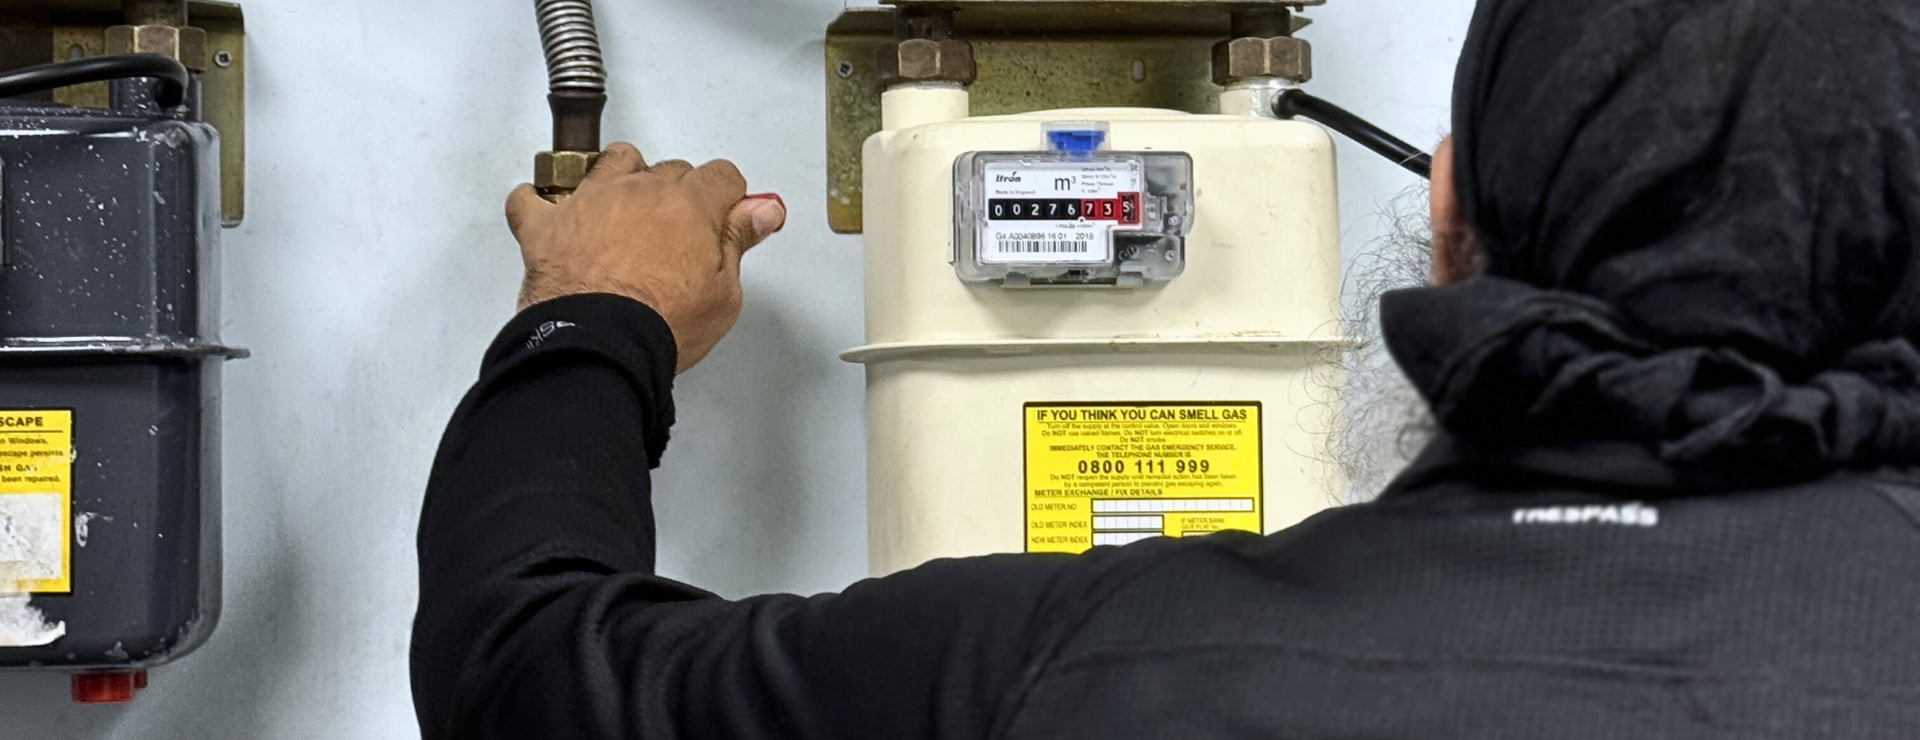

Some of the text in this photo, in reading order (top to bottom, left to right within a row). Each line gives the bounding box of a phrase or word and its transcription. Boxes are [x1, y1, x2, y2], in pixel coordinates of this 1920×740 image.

[1037, 409, 1247, 421] IF YOU THINK YOU CAN SMELL GAS
[1078, 459, 1210, 474] 0800 111 999
[1045, 503, 1066, 511] METER
